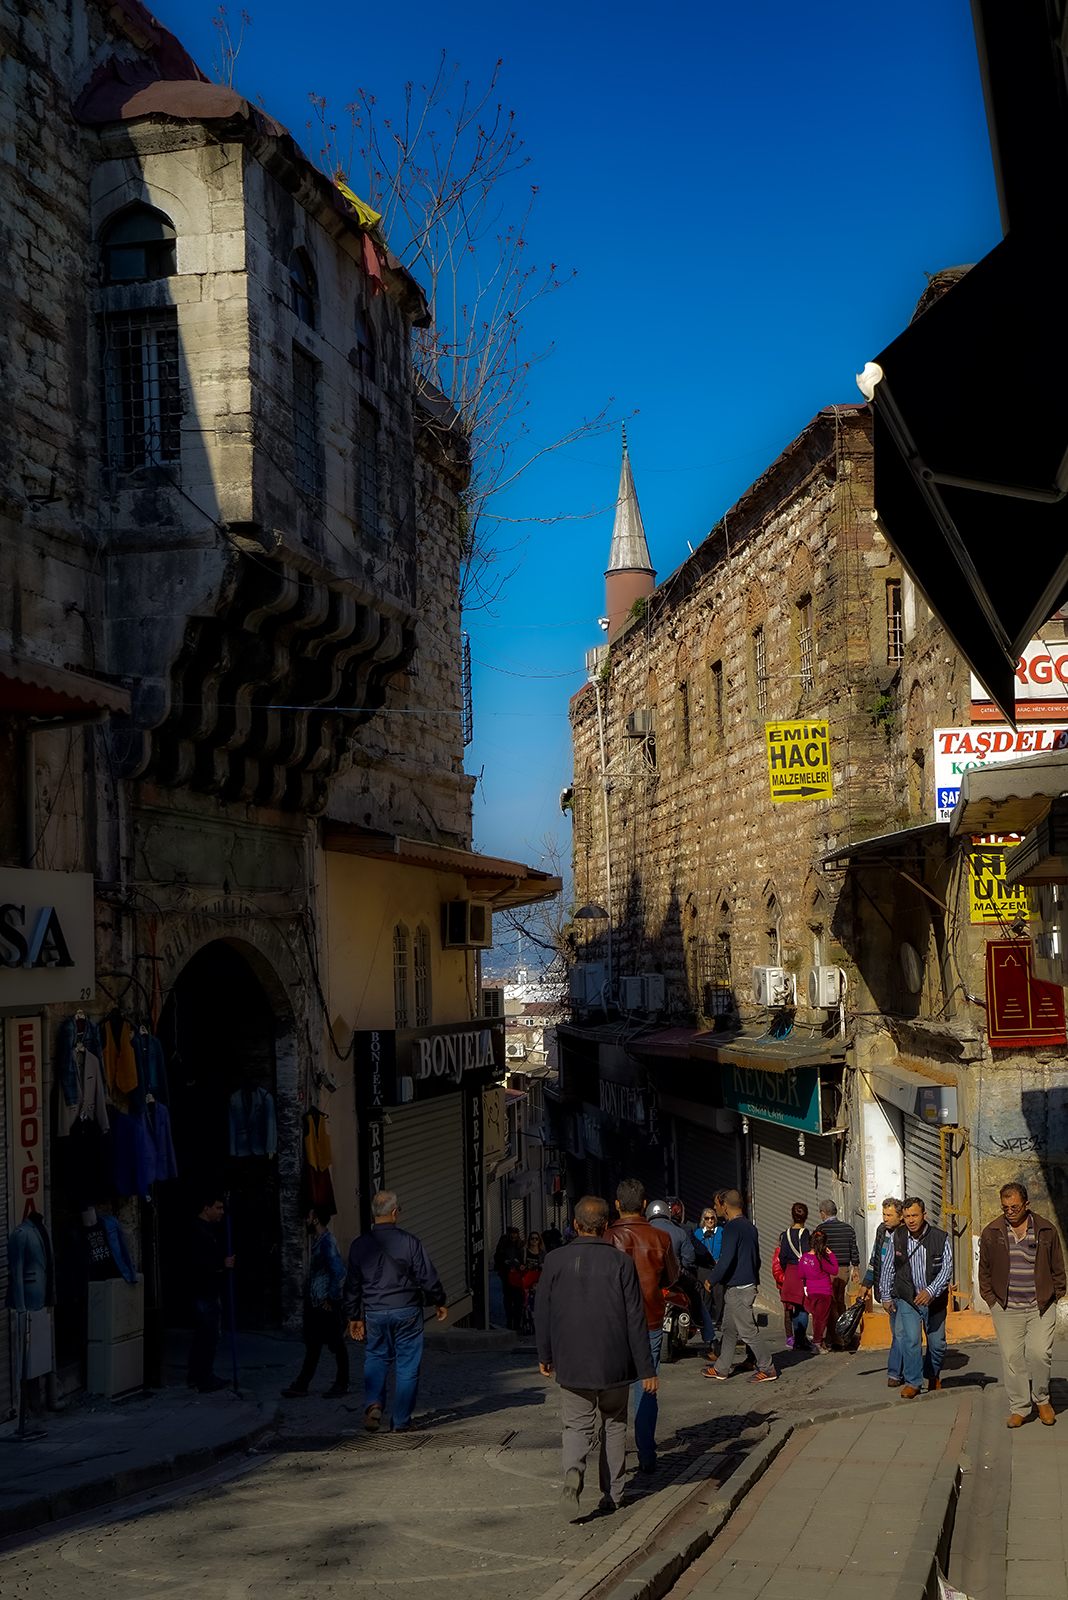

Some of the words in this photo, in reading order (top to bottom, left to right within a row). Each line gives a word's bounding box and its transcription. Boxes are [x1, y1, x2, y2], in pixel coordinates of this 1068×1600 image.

[769, 725, 827, 743] EMİN
[770, 741, 829, 770] HACI
[772, 767, 830, 786] MALZEMELERİ
[80, 987, 91, 1000] 29
[371, 1031, 382, 1106] BONJELA
[418, 1028, 496, 1085] BONJELA
[733, 1067, 801, 1108] KEVSER
